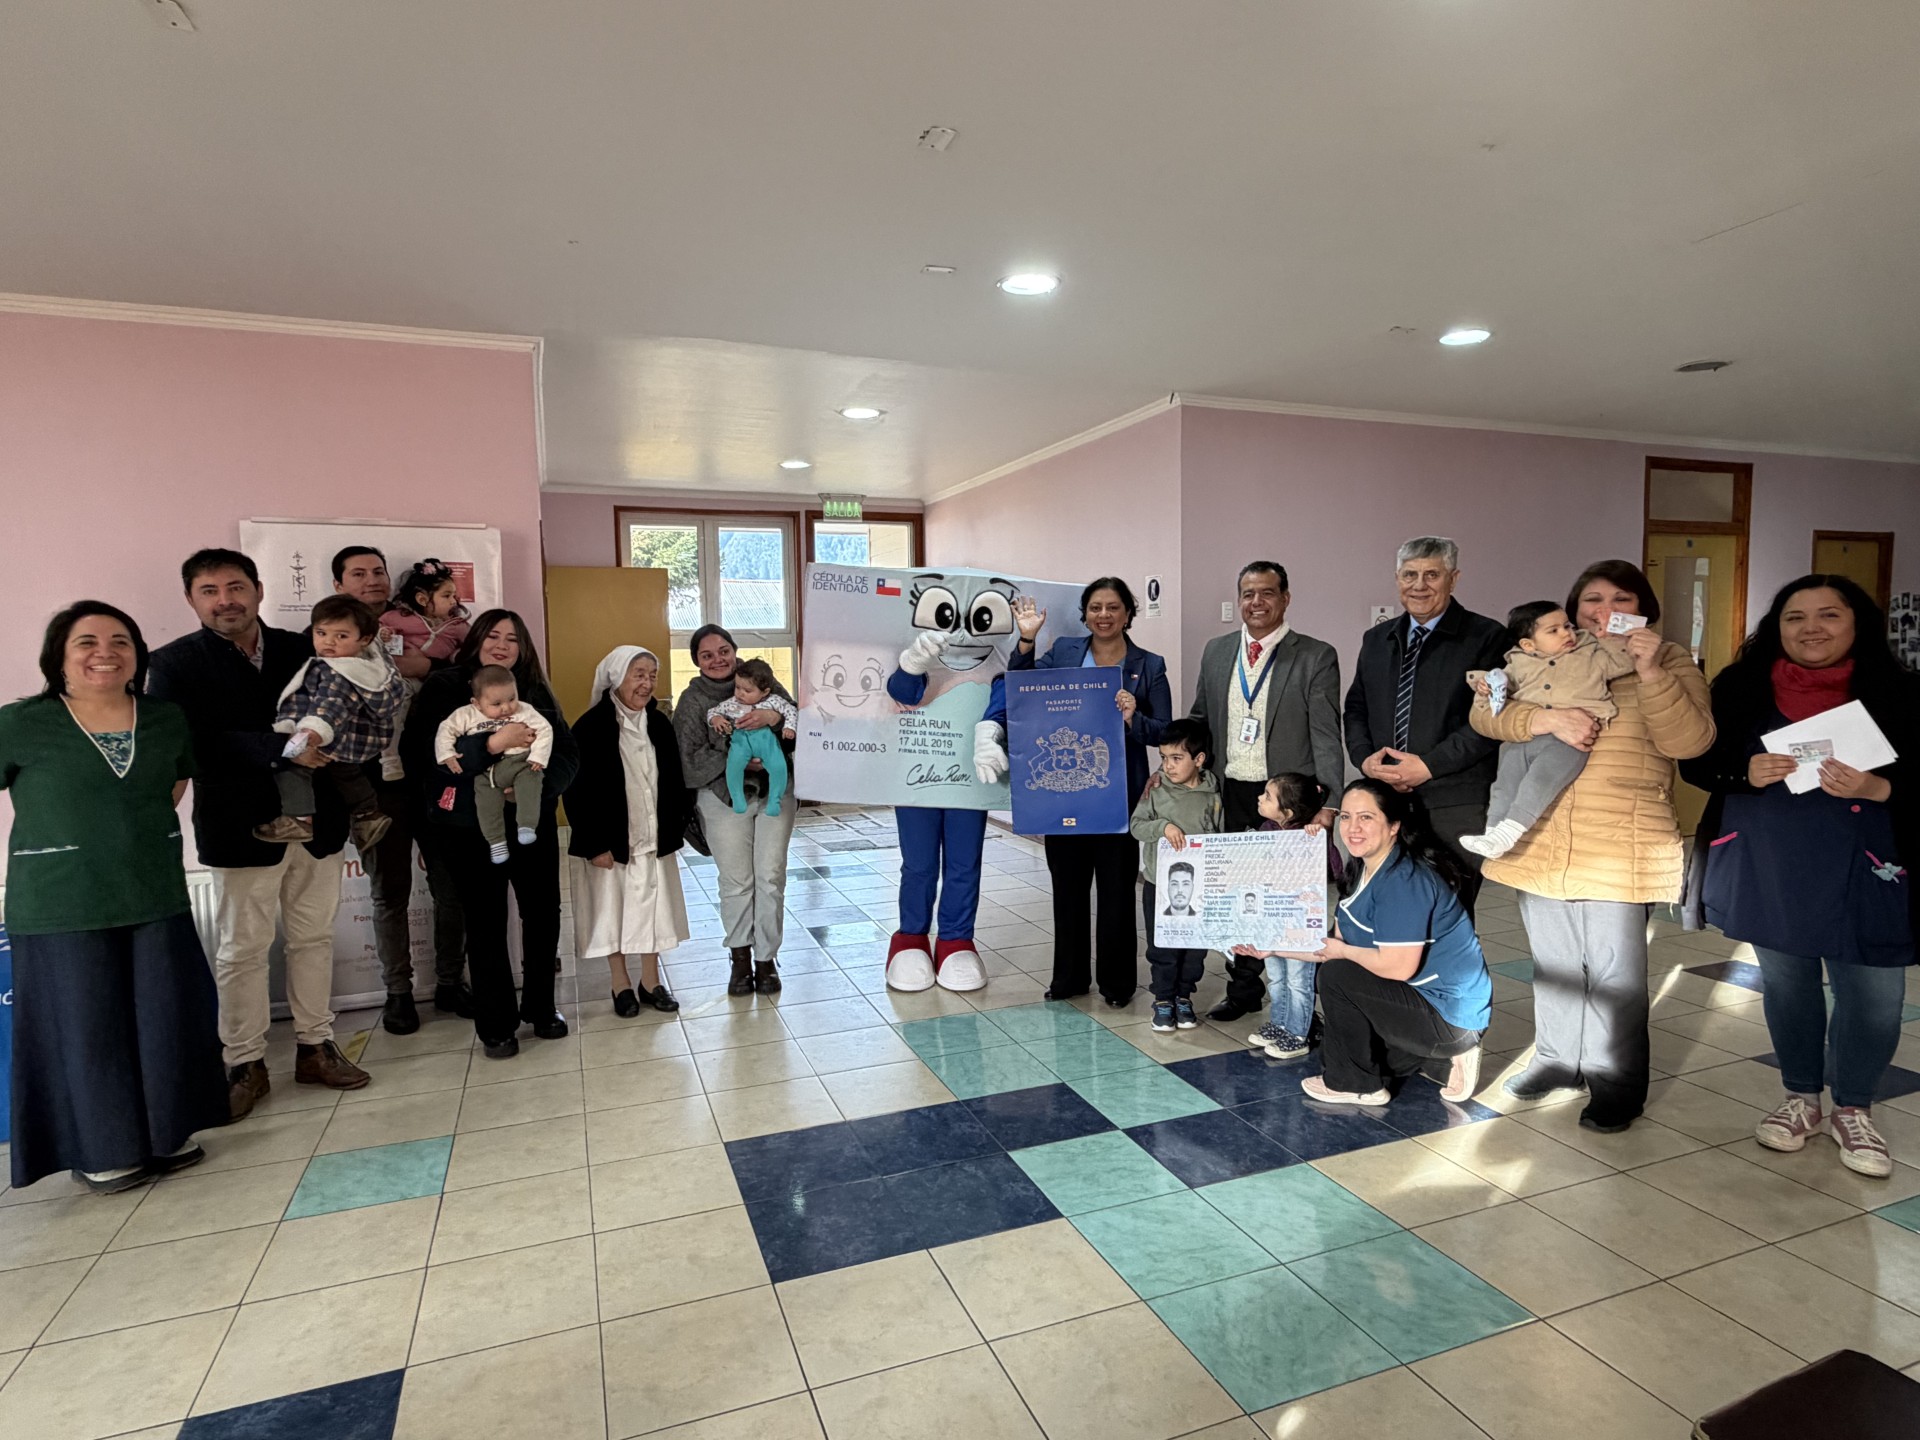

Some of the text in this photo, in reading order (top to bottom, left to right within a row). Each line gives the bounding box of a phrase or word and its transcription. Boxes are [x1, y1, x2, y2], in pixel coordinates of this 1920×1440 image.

[825, 508, 861, 518] SALIDA
[812, 571, 868, 585] CÉDULA DE
[812, 581, 868, 594] IDENTIDAD
[1019, 683, 1066, 693] REPÚBLICA
[1082, 682, 1108, 690] CHILE
[1045, 698, 1082, 706] PASAPORTE
[899, 717, 951, 730] CELIA RUN
[928, 731, 964, 739] NACIMIENTO
[899, 736, 953, 749] 17 JUL 2019
[906, 763, 944, 786] Celia
[1255, 834, 1276, 842] CHILE
